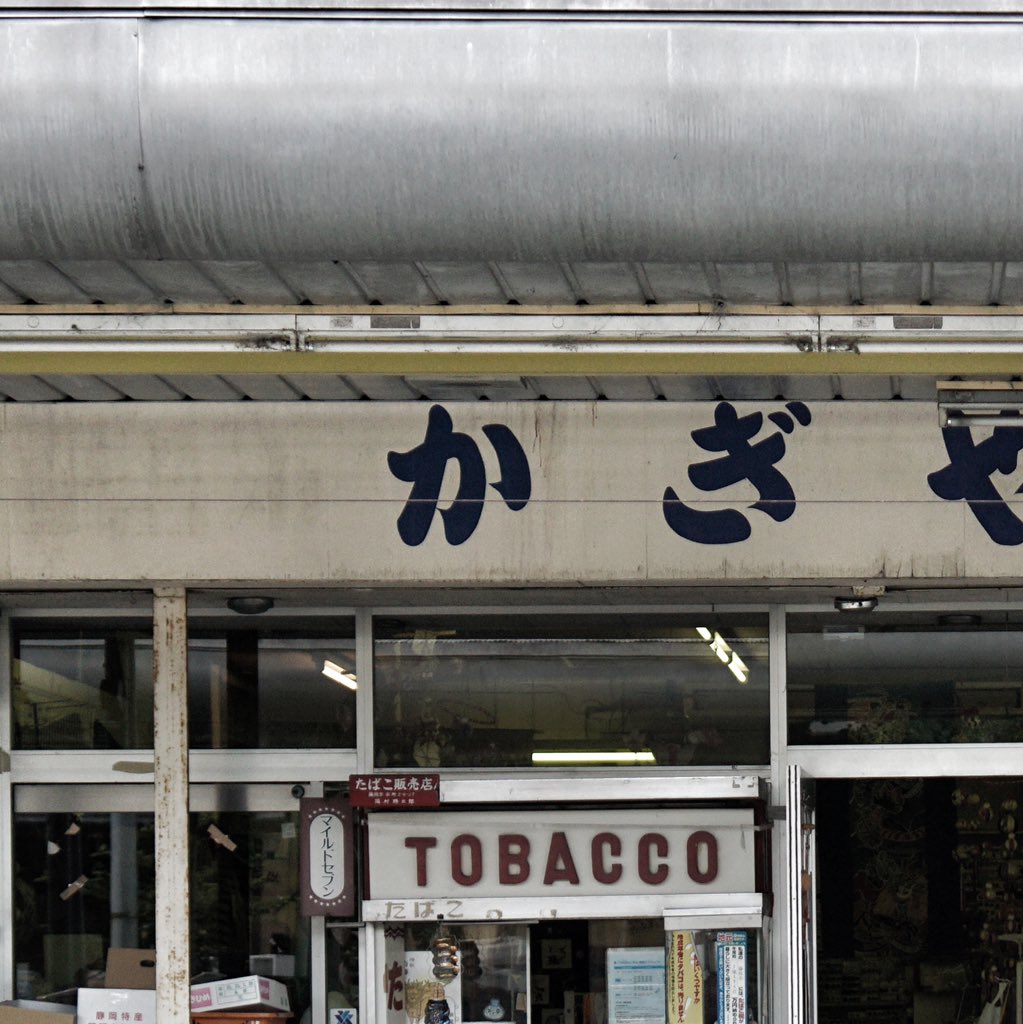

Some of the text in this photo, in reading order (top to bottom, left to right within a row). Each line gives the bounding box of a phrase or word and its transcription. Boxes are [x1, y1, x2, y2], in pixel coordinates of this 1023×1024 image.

[355, 777, 432, 791] たばこ販売店
[404, 831, 719, 887] TOBACCO
